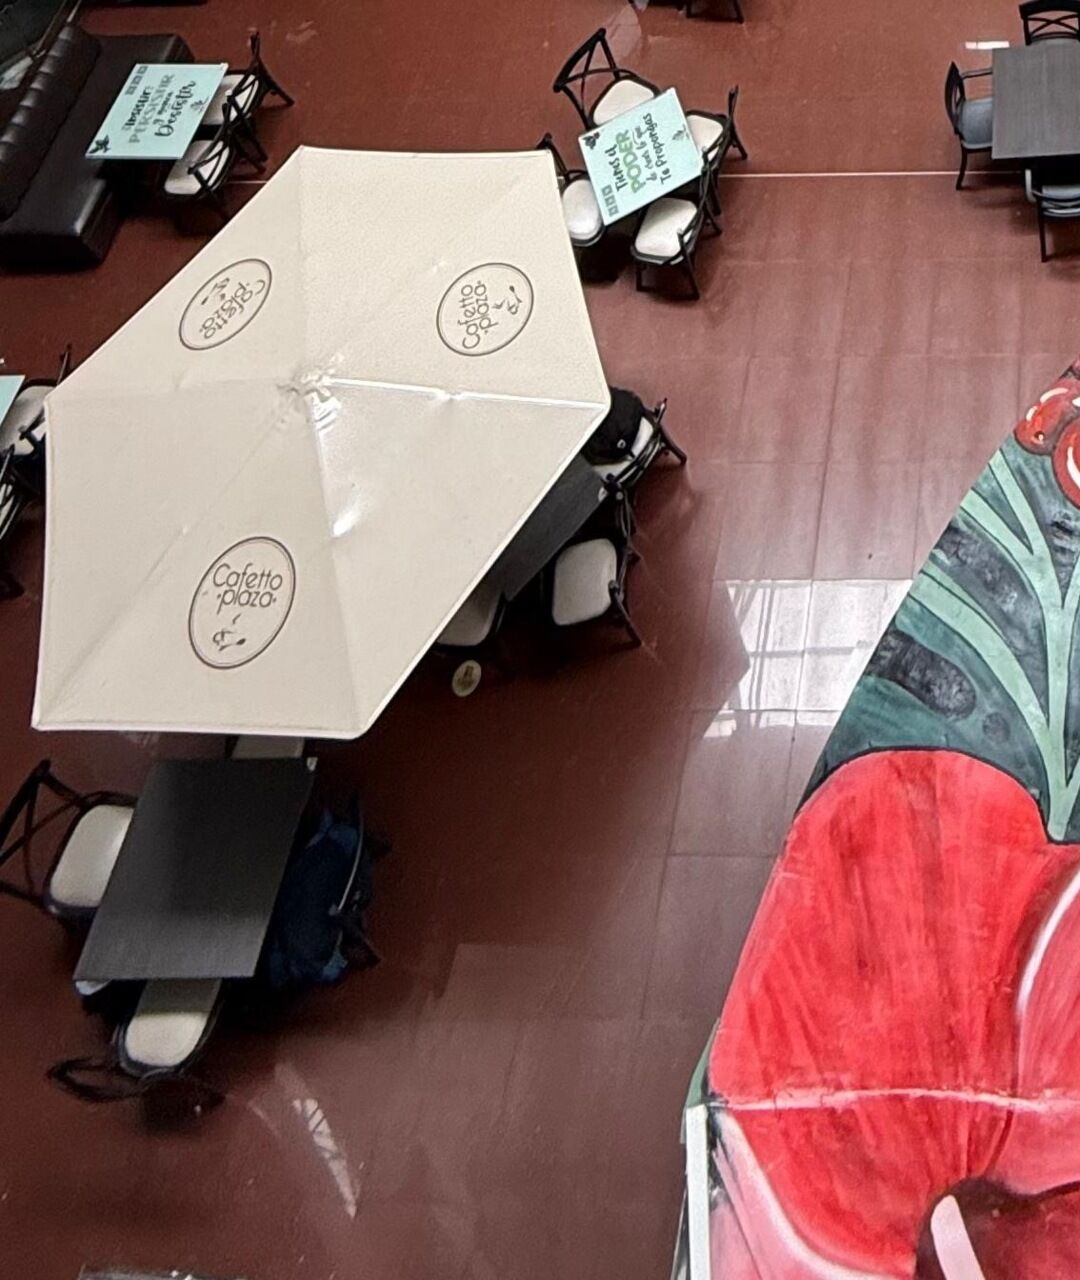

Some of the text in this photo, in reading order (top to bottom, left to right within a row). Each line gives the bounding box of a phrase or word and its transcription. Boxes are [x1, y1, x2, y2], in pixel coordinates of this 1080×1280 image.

[604, 144, 628, 192] Tienes el
[615, 130, 642, 193] PODER
[643, 113, 671, 184] Te Propongas
[457, 284, 481, 349] Cafetto
[213, 562, 283, 591] Cafetto
